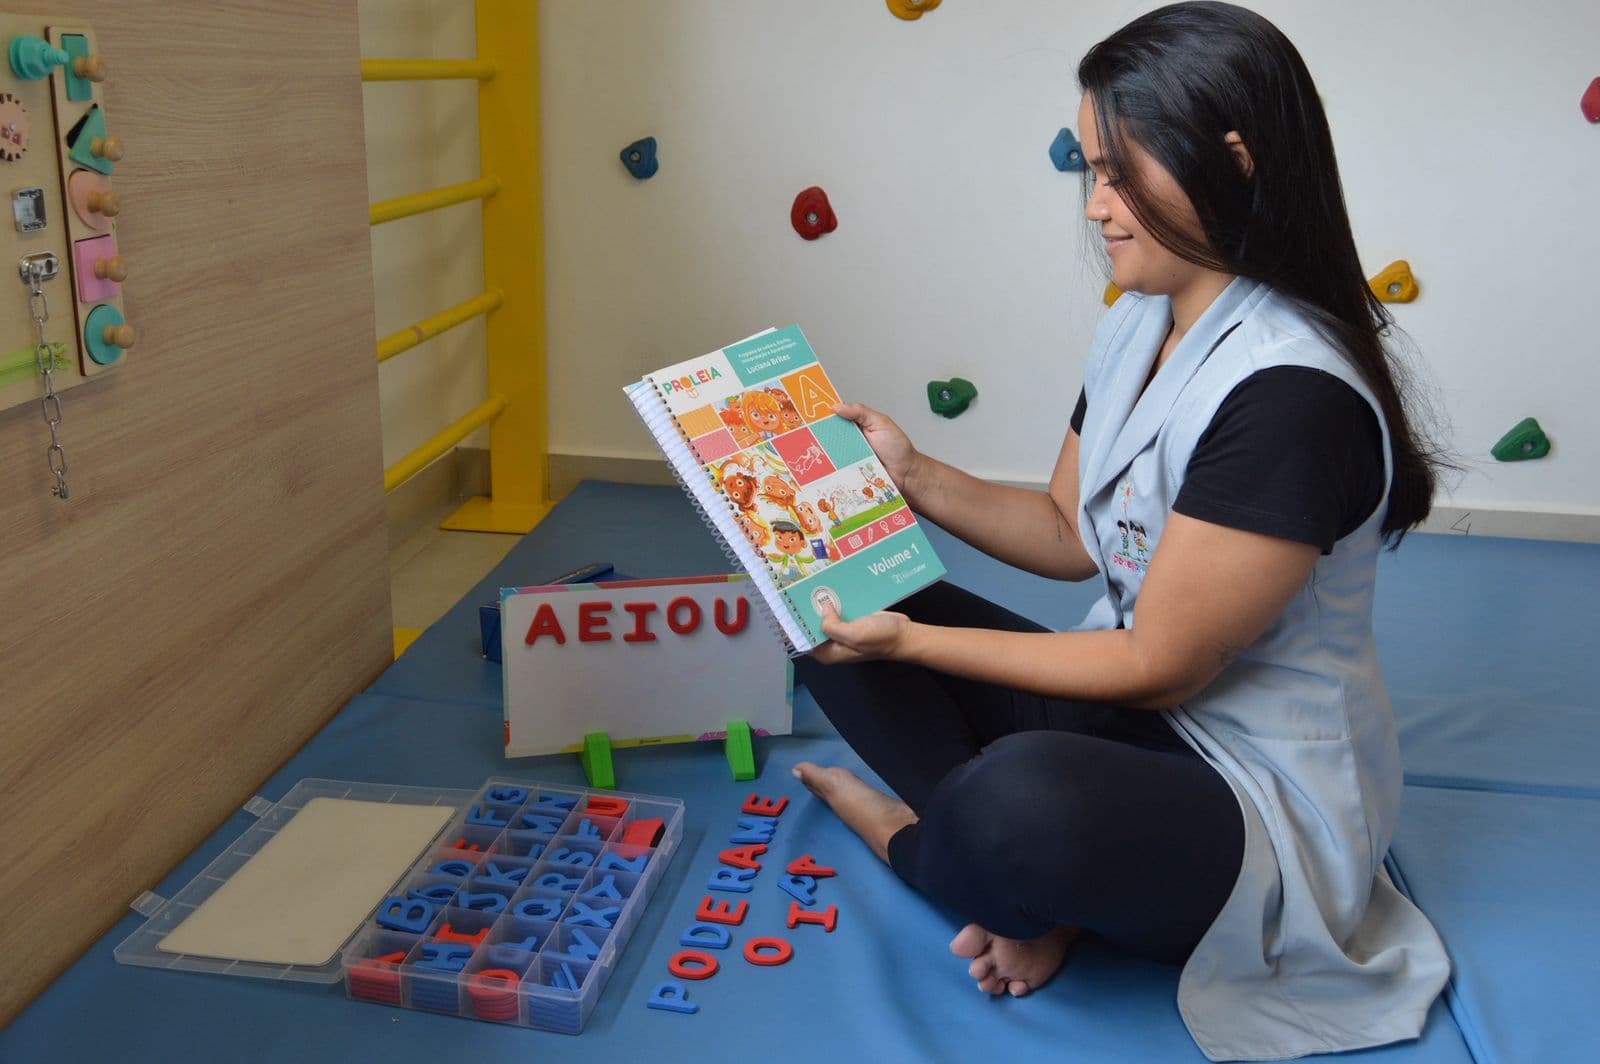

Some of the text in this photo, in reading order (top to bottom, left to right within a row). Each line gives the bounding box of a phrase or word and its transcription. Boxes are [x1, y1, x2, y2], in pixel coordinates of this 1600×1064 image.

[746, 354, 791, 374] Luciana Brites
[662, 366, 722, 395] PROLEIA
[799, 374, 837, 417] A
[867, 549, 912, 576] Volume
[911, 543, 920, 554] 1
[376, 896, 433, 934] B
[564, 902, 621, 929] X
